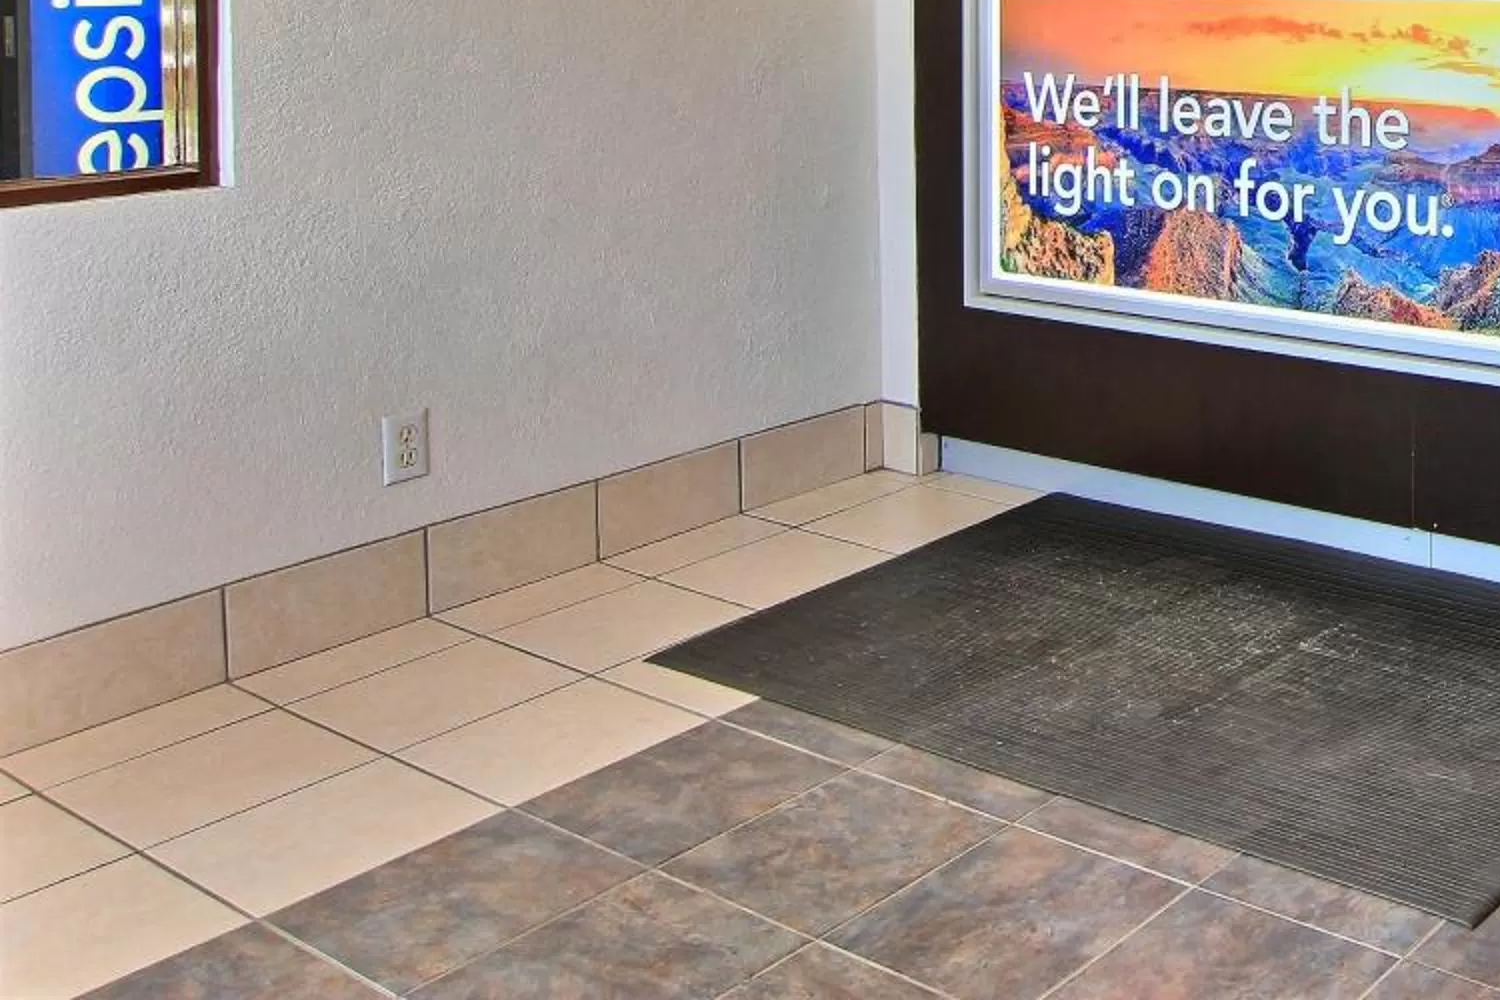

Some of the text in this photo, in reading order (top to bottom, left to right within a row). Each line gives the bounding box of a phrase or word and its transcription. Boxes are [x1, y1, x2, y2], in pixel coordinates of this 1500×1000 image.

[1023, 72, 1409, 151] We'll leave the
[1028, 142, 1135, 216] light
[1151, 170, 1216, 214] on
[1234, 158, 1315, 222] for
